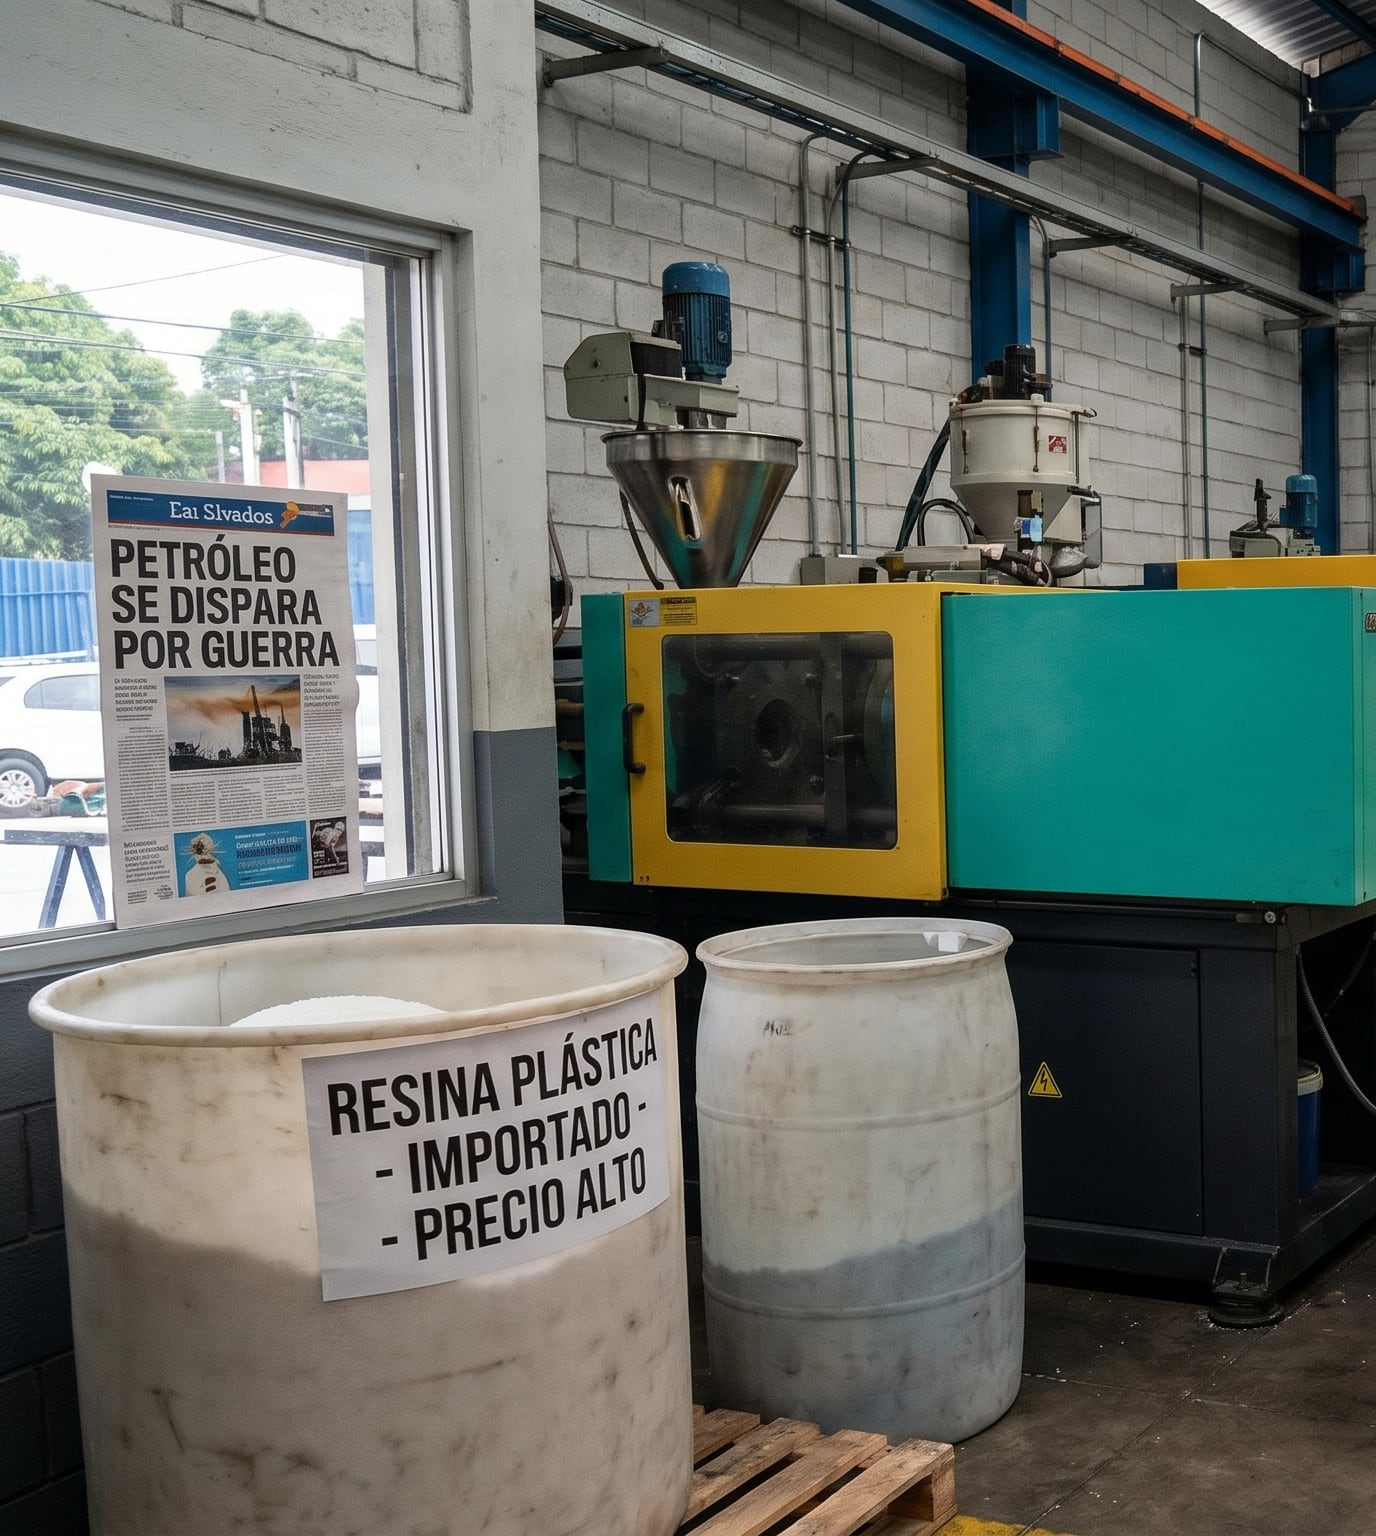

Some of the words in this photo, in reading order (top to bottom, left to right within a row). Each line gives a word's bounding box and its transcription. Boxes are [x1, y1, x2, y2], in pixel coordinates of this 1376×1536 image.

[110, 533, 296, 584] PETRÓLEO
[111, 584, 160, 624] SE
[169, 585, 323, 625] DISPARA
[113, 630, 193, 670] POR
[201, 630, 341, 669] GUERRA
[327, 1062, 501, 1136] RESINA
[510, 1017, 658, 1107] PLÁSTICA
[407, 1091, 631, 1194] IMPORTADO
[414, 1178, 565, 1261] PRECIO
[576, 1147, 646, 1220] ALTO
